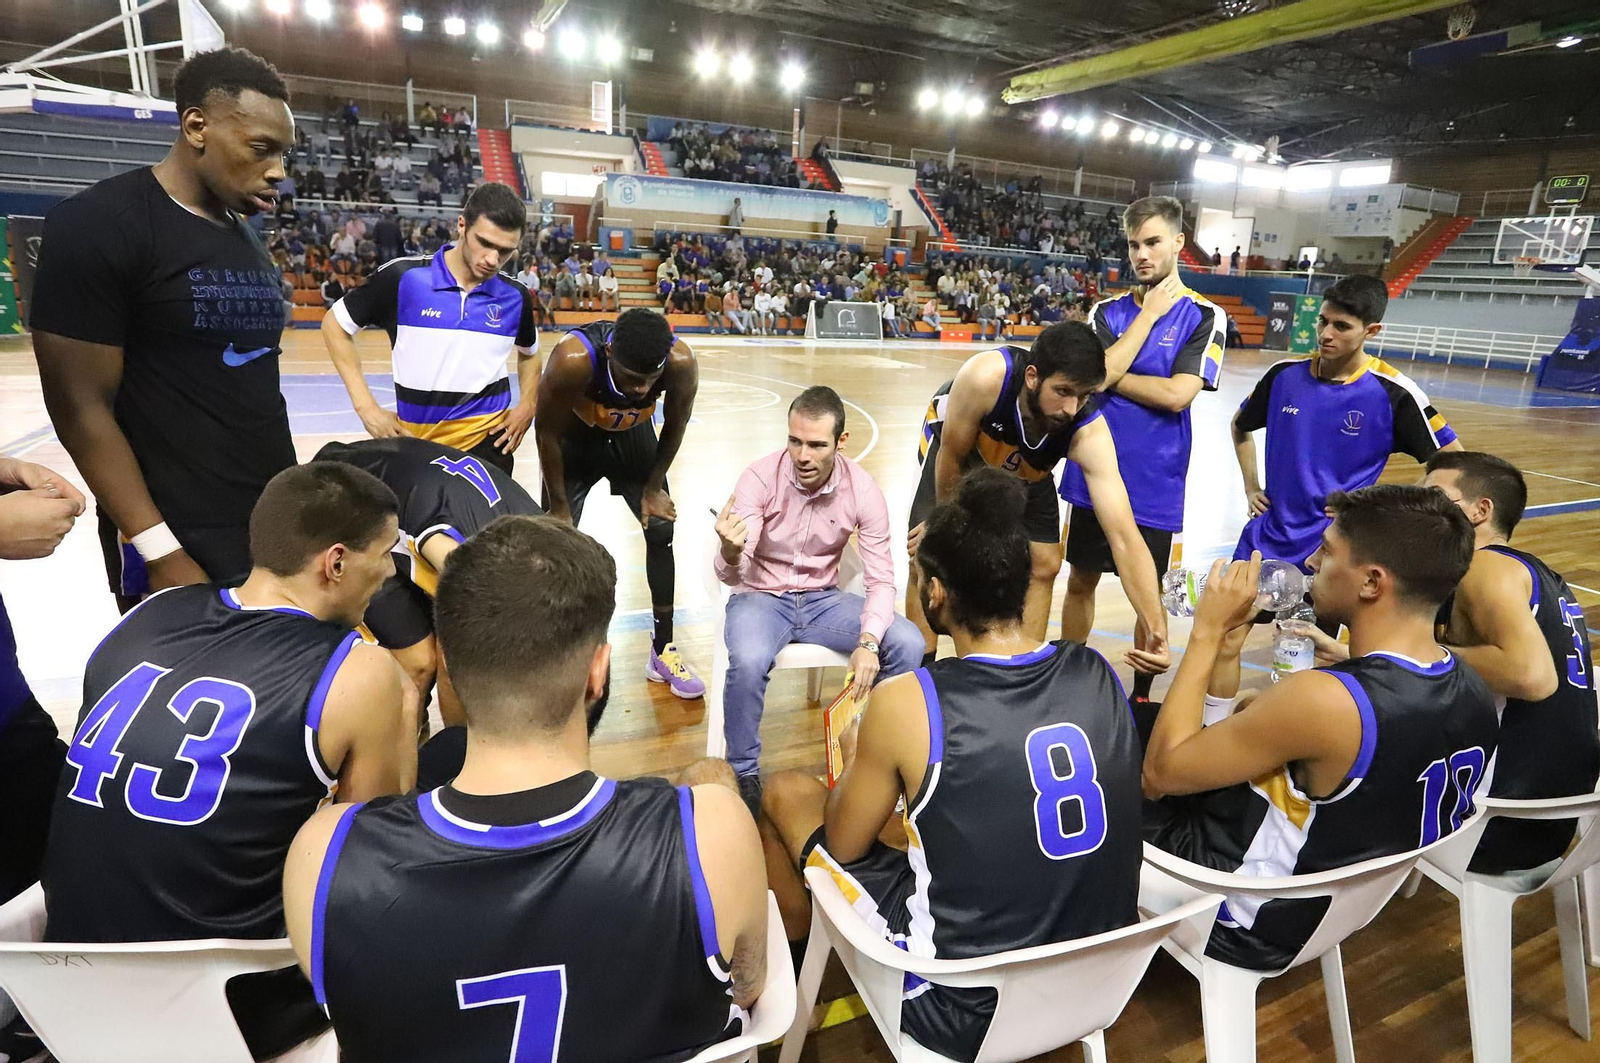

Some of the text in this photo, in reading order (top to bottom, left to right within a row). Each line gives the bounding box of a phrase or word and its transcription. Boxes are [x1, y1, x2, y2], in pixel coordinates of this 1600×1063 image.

[420, 307, 442, 318] vive
[608, 410, 641, 429] 77
[1281, 404, 1300, 415] vive
[1001, 449, 1022, 472] 9
[429, 455, 502, 508] 4
[65, 661, 257, 826] 43
[1024, 722, 1108, 861] 8
[455, 963, 568, 1063] 7
